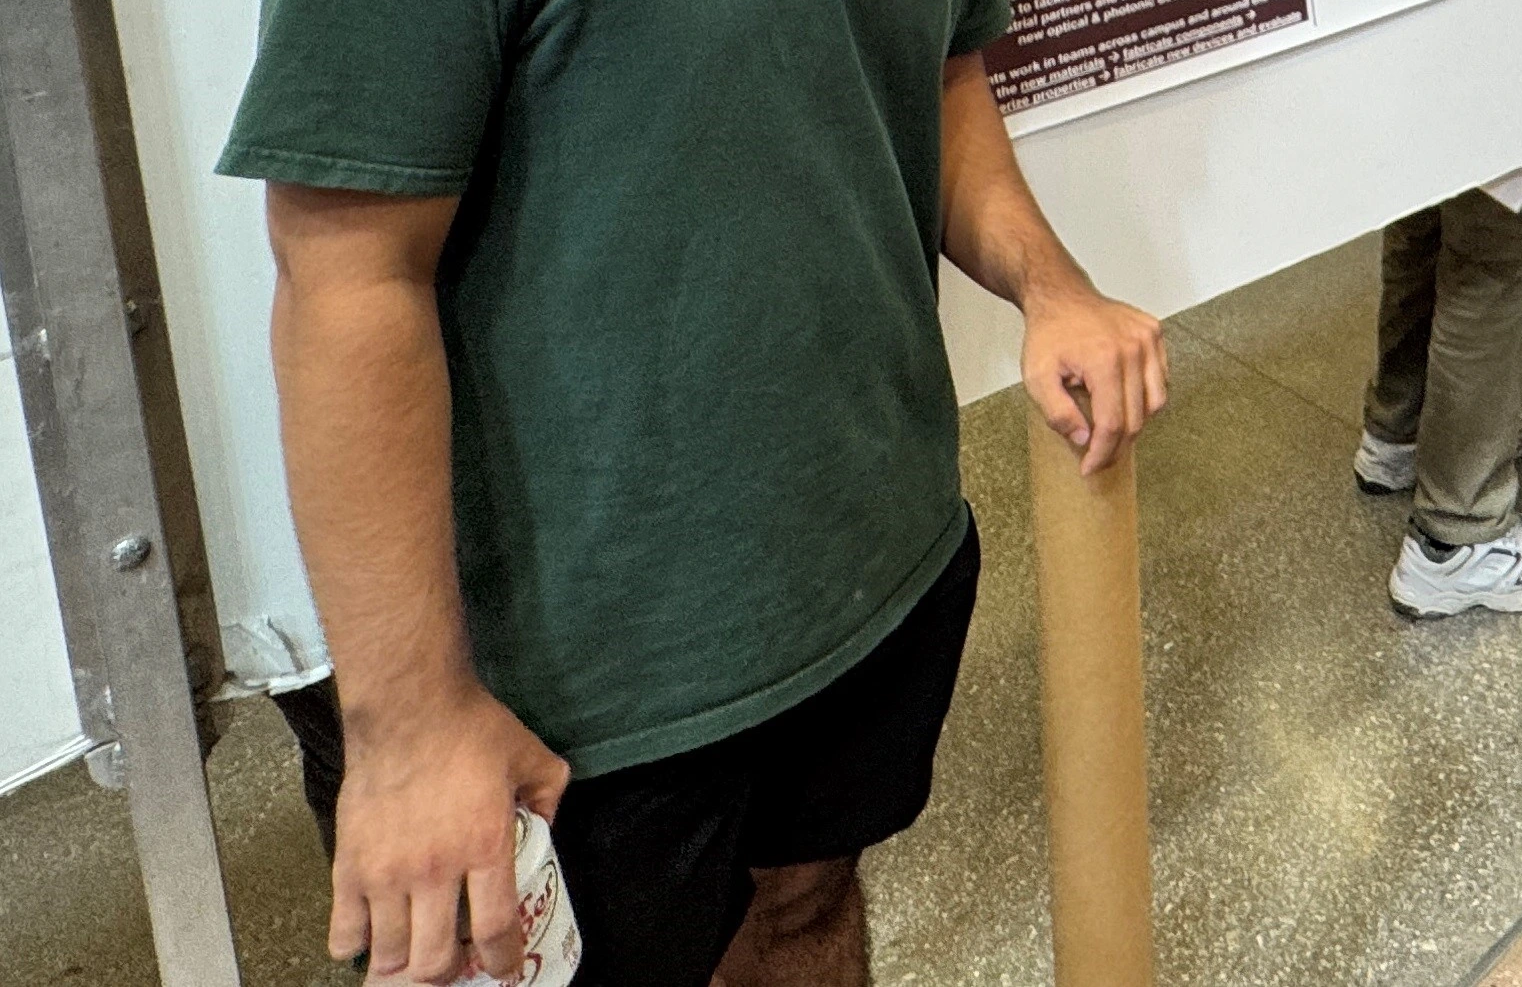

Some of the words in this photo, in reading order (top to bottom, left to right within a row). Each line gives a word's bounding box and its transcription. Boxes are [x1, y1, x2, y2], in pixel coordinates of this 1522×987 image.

[1018, 2, 1032, 14] to
[1017, 30, 1044, 45] new
[1046, 15, 1088, 37] optical
[1008, 61, 1041, 78] work
[1043, 57, 1057, 69] in
[1058, 45, 1096, 64] teams
[995, 84, 1017, 98] the
[1019, 75, 1047, 93] new
